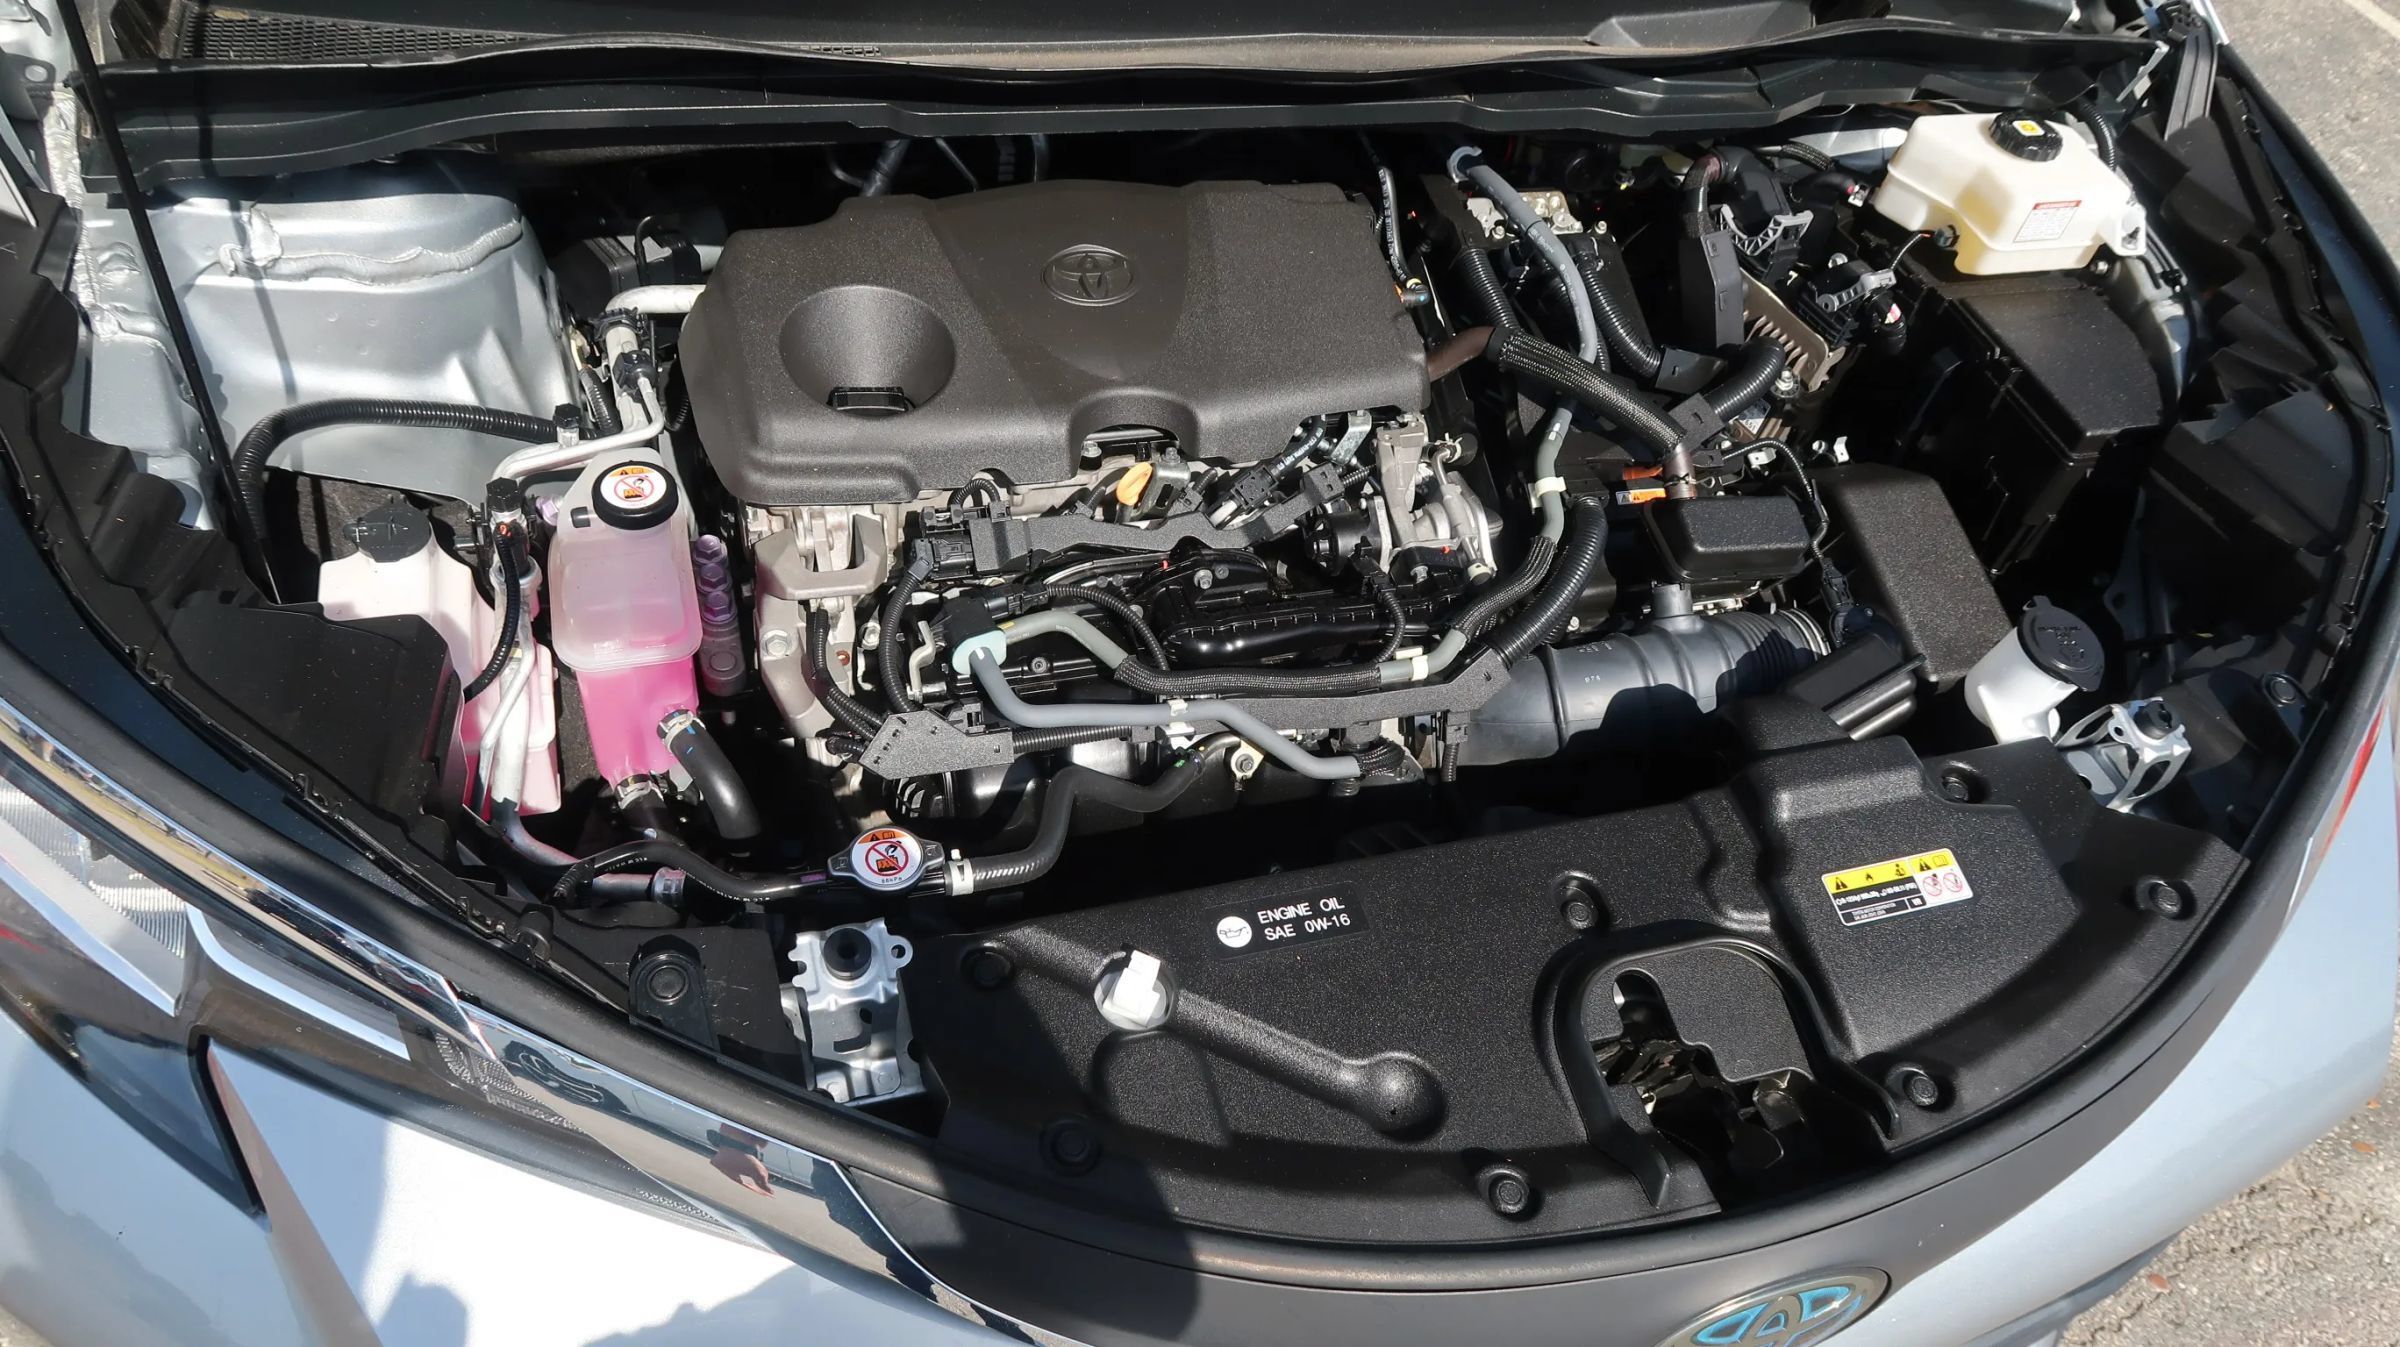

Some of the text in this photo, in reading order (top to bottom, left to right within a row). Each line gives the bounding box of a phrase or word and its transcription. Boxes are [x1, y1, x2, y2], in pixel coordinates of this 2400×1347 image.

[1257, 897, 1345, 924] ENGINE OIL
[1264, 913, 1351, 941] SAE 0W-16
